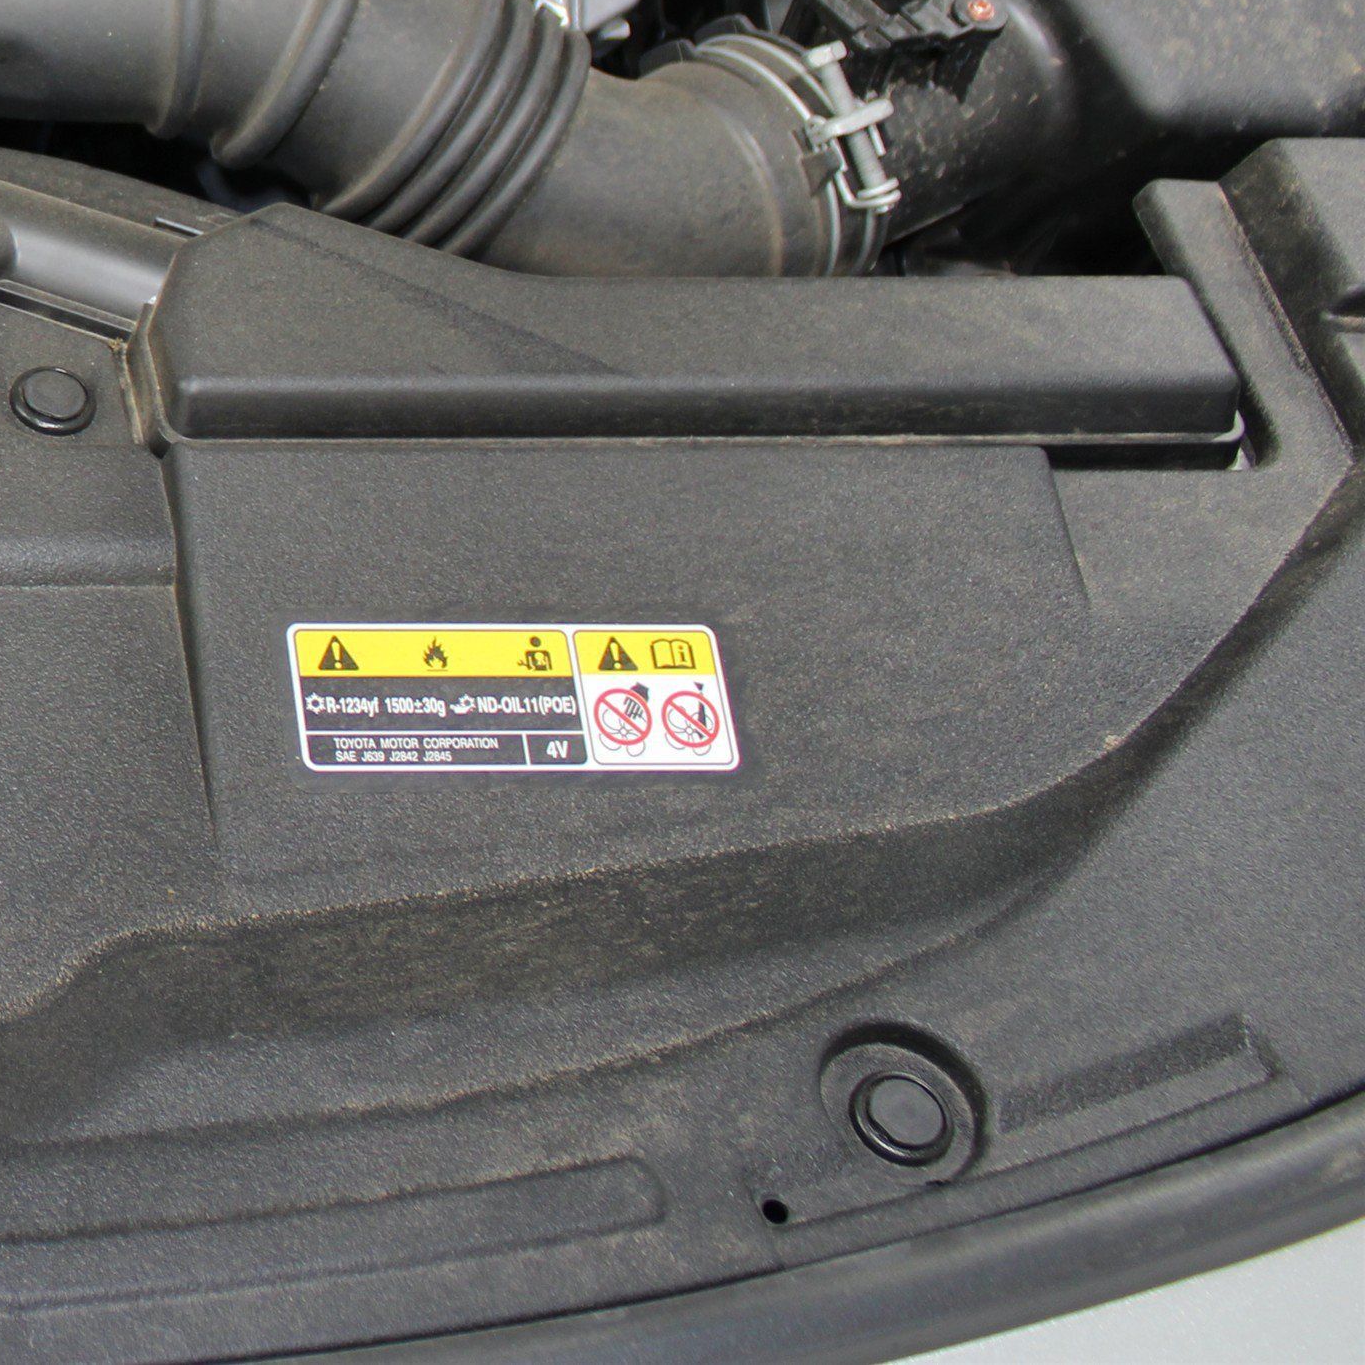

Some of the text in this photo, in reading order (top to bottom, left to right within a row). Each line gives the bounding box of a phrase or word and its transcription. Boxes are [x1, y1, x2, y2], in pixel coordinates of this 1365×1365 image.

[325, 695, 577, 718] R-1234yf 1500±30g ND-OIL11(POE)
[333, 737, 499, 749] TOYOTA MOTOR CORPORATION
[546, 740, 568, 758] 4V
[335, 750, 452, 762] SAE J639 J2842 J2845
